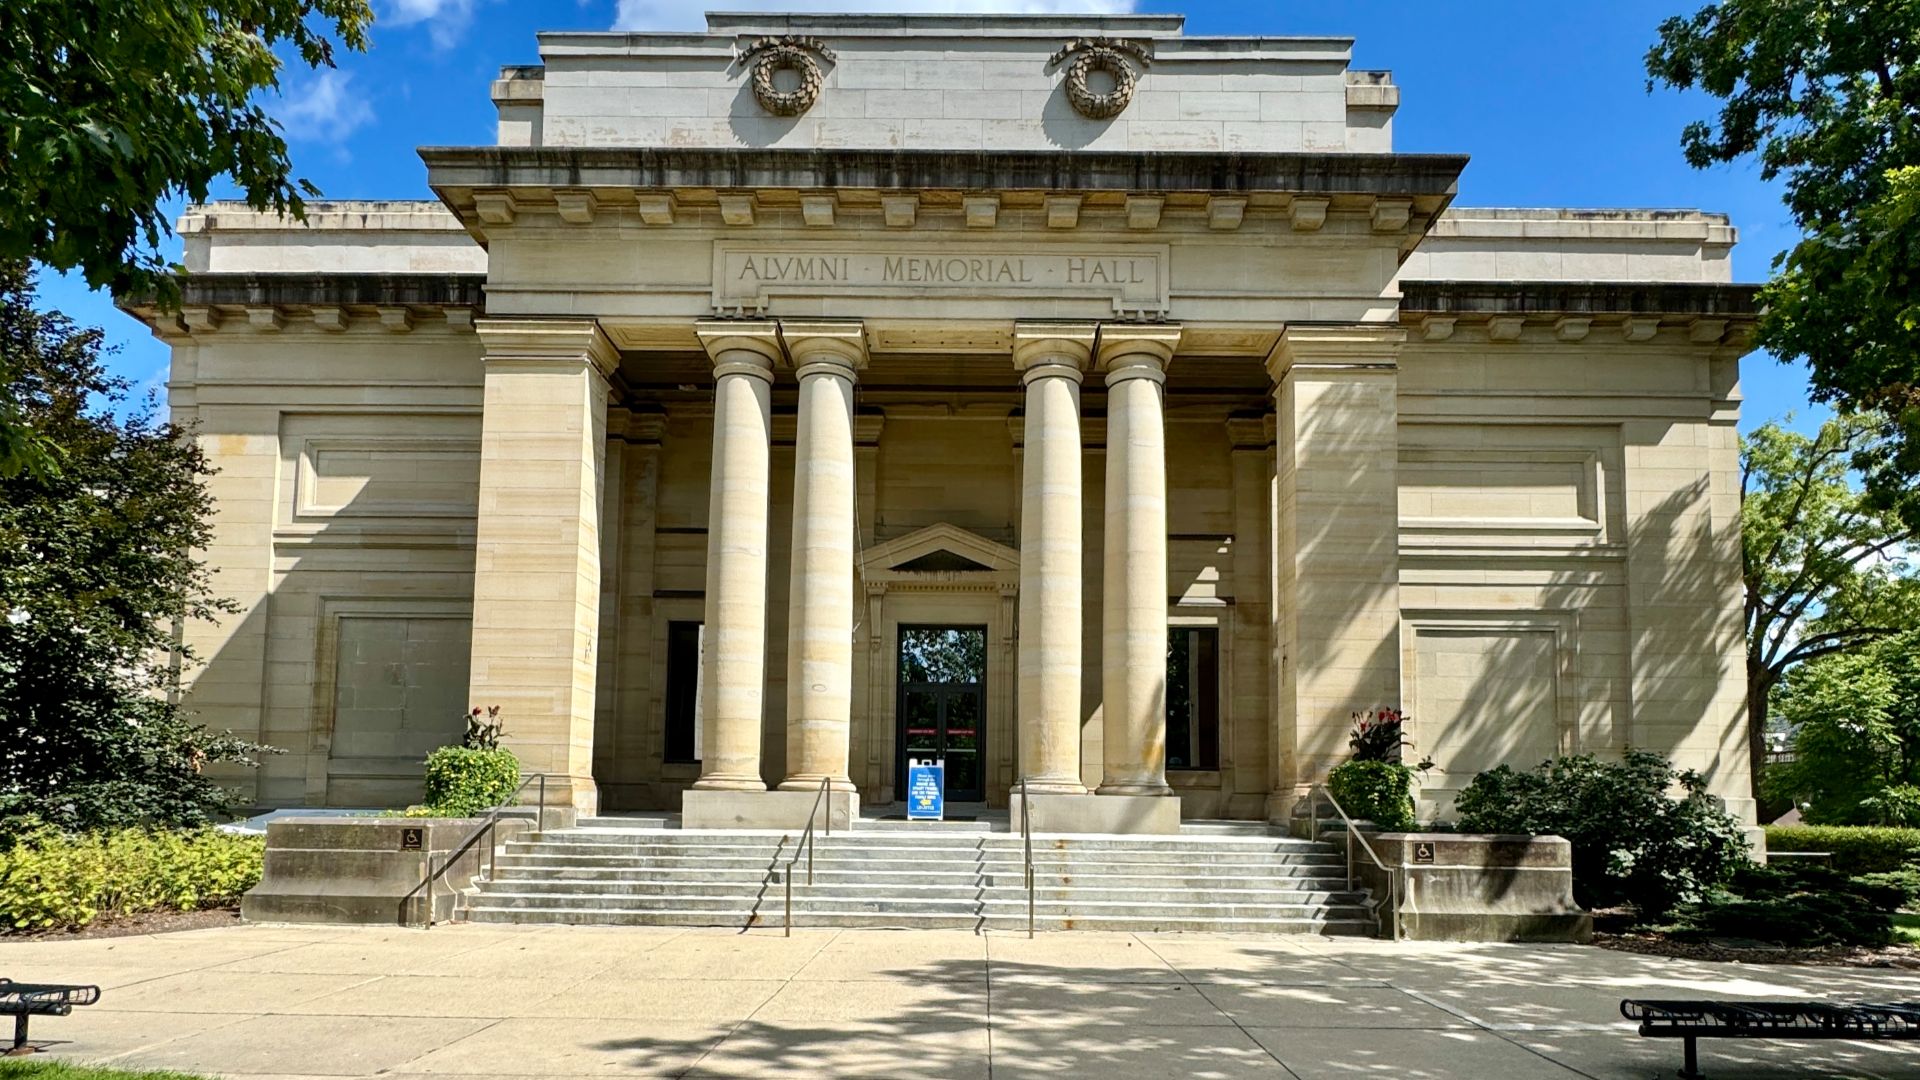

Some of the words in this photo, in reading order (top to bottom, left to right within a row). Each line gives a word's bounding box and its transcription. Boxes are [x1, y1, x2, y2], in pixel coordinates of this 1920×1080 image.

[738, 255, 849, 281] ALVMNI
[882, 256, 1033, 283] MEMORIAL
[1066, 258, 1145, 284] HALL
